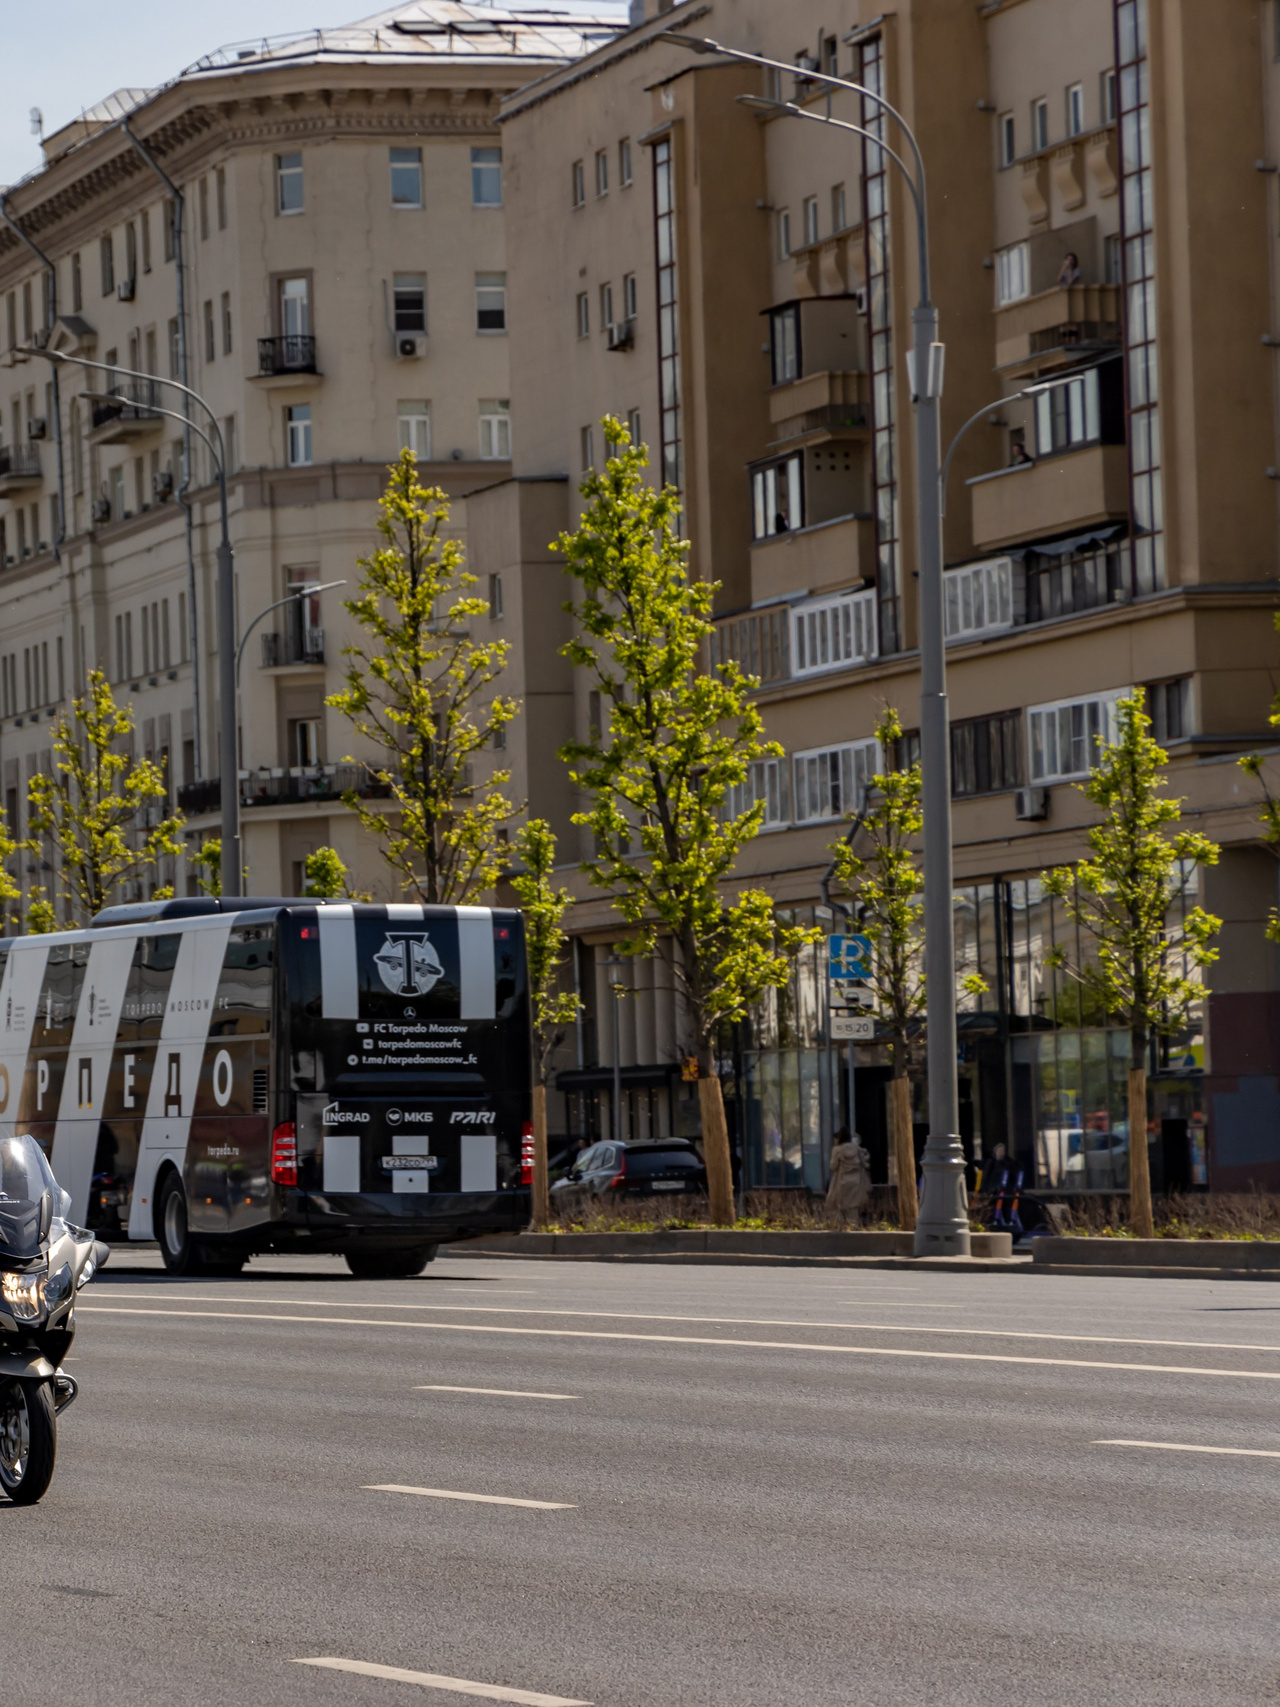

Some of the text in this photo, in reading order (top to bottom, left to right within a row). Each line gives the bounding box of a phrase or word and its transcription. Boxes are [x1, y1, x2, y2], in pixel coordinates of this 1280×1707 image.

[841, 938, 865, 975] P
[373, 1022, 469, 1036] FC Torpedo Moscow
[856, 1022, 869, 1033] 20
[377, 1038, 463, 1051] torpedomoscowfc
[361, 1053, 478, 1067] t.me/torpedomoscow_fc
[325, 1111, 371, 1123] INGRAD
[403, 1111, 435, 1123] МКБ
[449, 1111, 497, 1124] PARI
